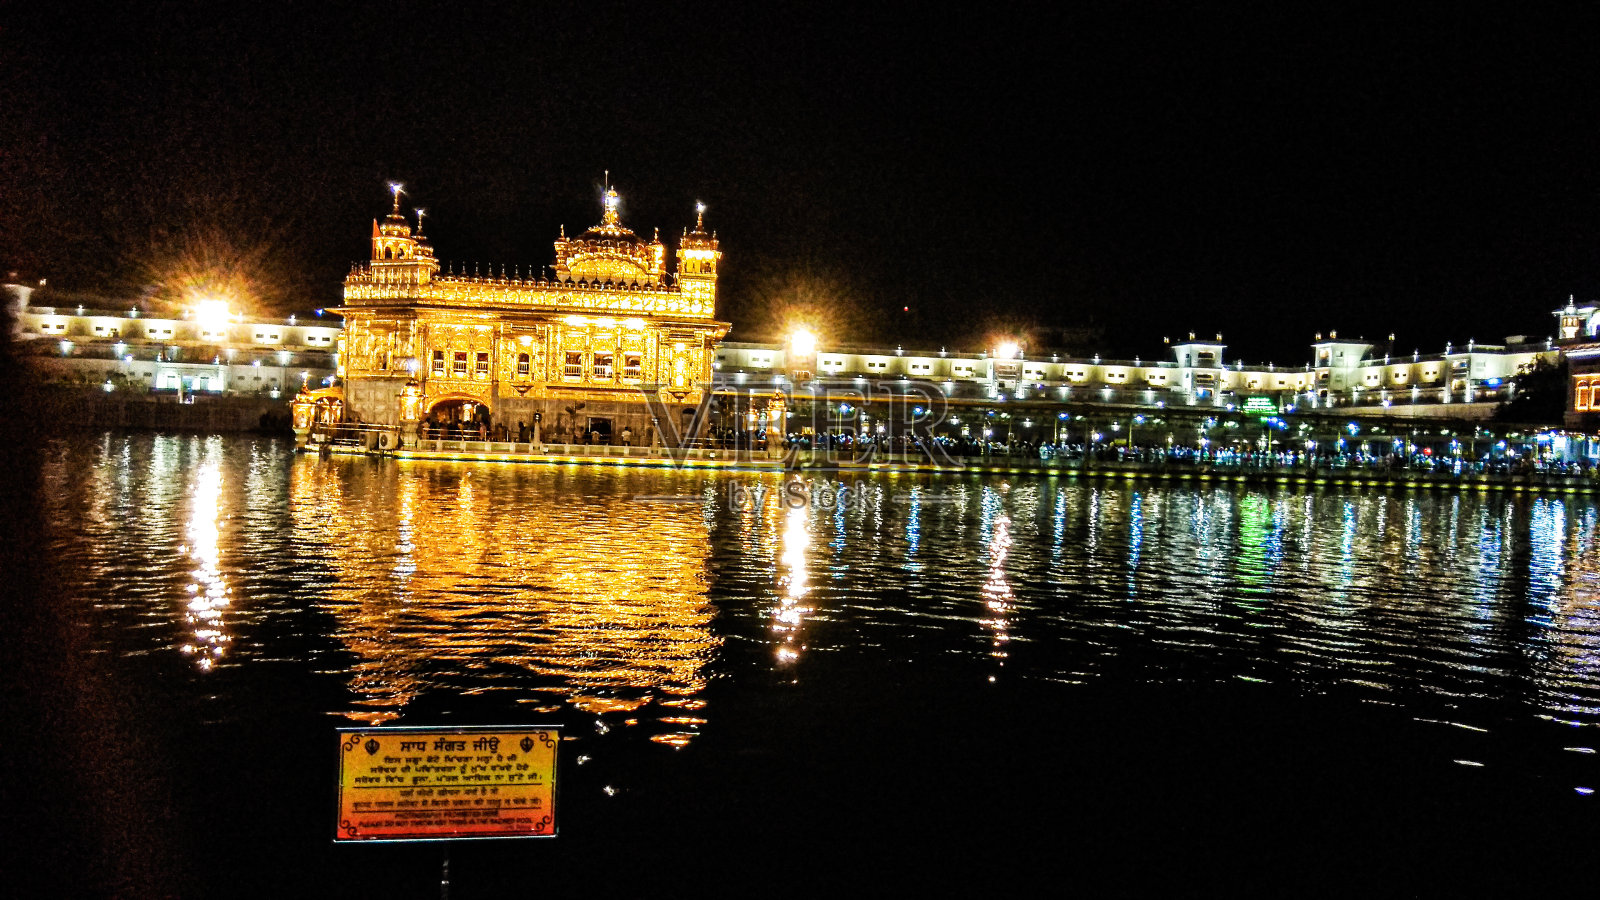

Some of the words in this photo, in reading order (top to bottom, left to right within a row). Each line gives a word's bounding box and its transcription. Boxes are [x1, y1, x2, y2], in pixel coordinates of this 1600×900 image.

[401, 741, 426, 752] ਸਾਧ
[434, 738, 465, 751] ਸੰਗਤ
[473, 737, 500, 753] ਜੀਉ
